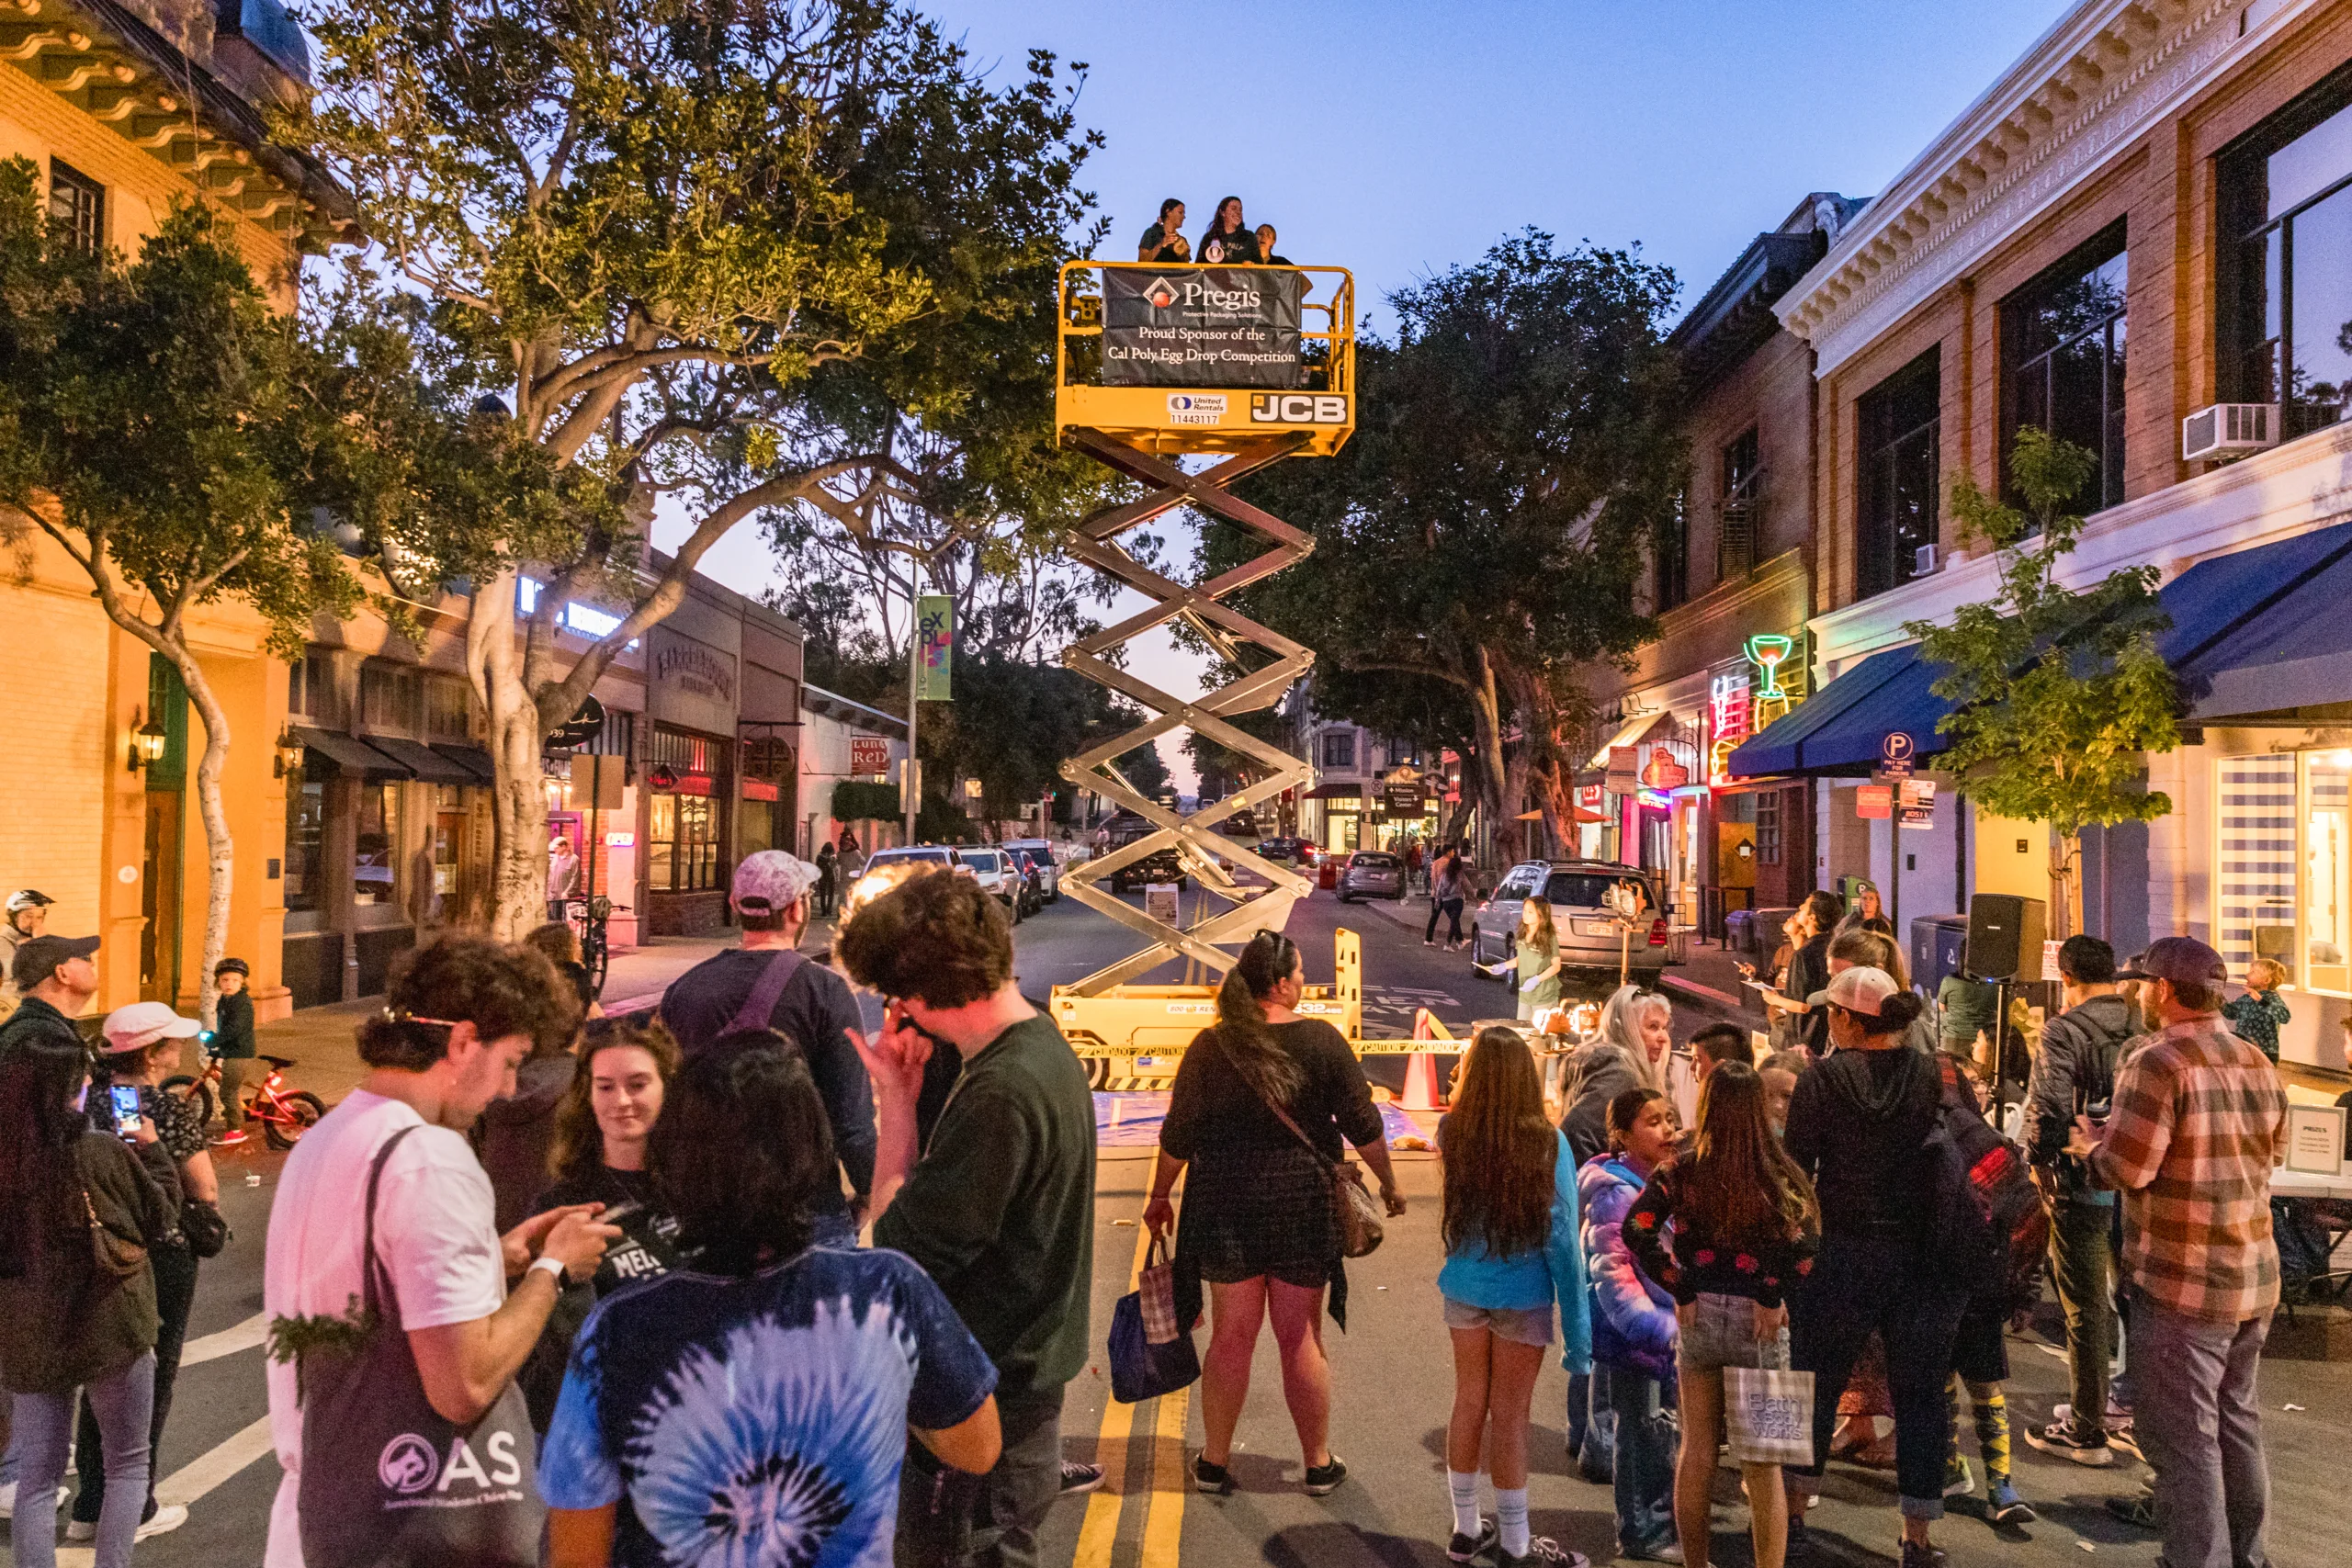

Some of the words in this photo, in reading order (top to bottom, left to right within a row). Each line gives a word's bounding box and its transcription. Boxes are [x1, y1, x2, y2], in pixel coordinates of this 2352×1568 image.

[1183, 283, 1261, 310] Pregis
[1139, 327, 1176, 339] Proud
[1179, 328, 1227, 343] Sponsor
[1230, 328, 1246, 340] of
[1247, 329, 1265, 341] the
[1108, 347, 1128, 359] Cal
[1132, 347, 1158, 363] Poly
[1161, 349, 1183, 364] Egg
[1186, 349, 1217, 364] Drop
[1221, 349, 1295, 365] Competition
[1252, 395, 1346, 423] JCB
[1171, 415, 1217, 424] 11443117
[1149, 1047, 1184, 1055] CAUTION
[1364, 1043, 1400, 1052] CAUTION
[1748, 1393, 1801, 1412] Bath
[1765, 1412, 1798, 1427] Body
[1752, 1424, 1803, 1439] Works
[436, 1431, 521, 1491] AS
